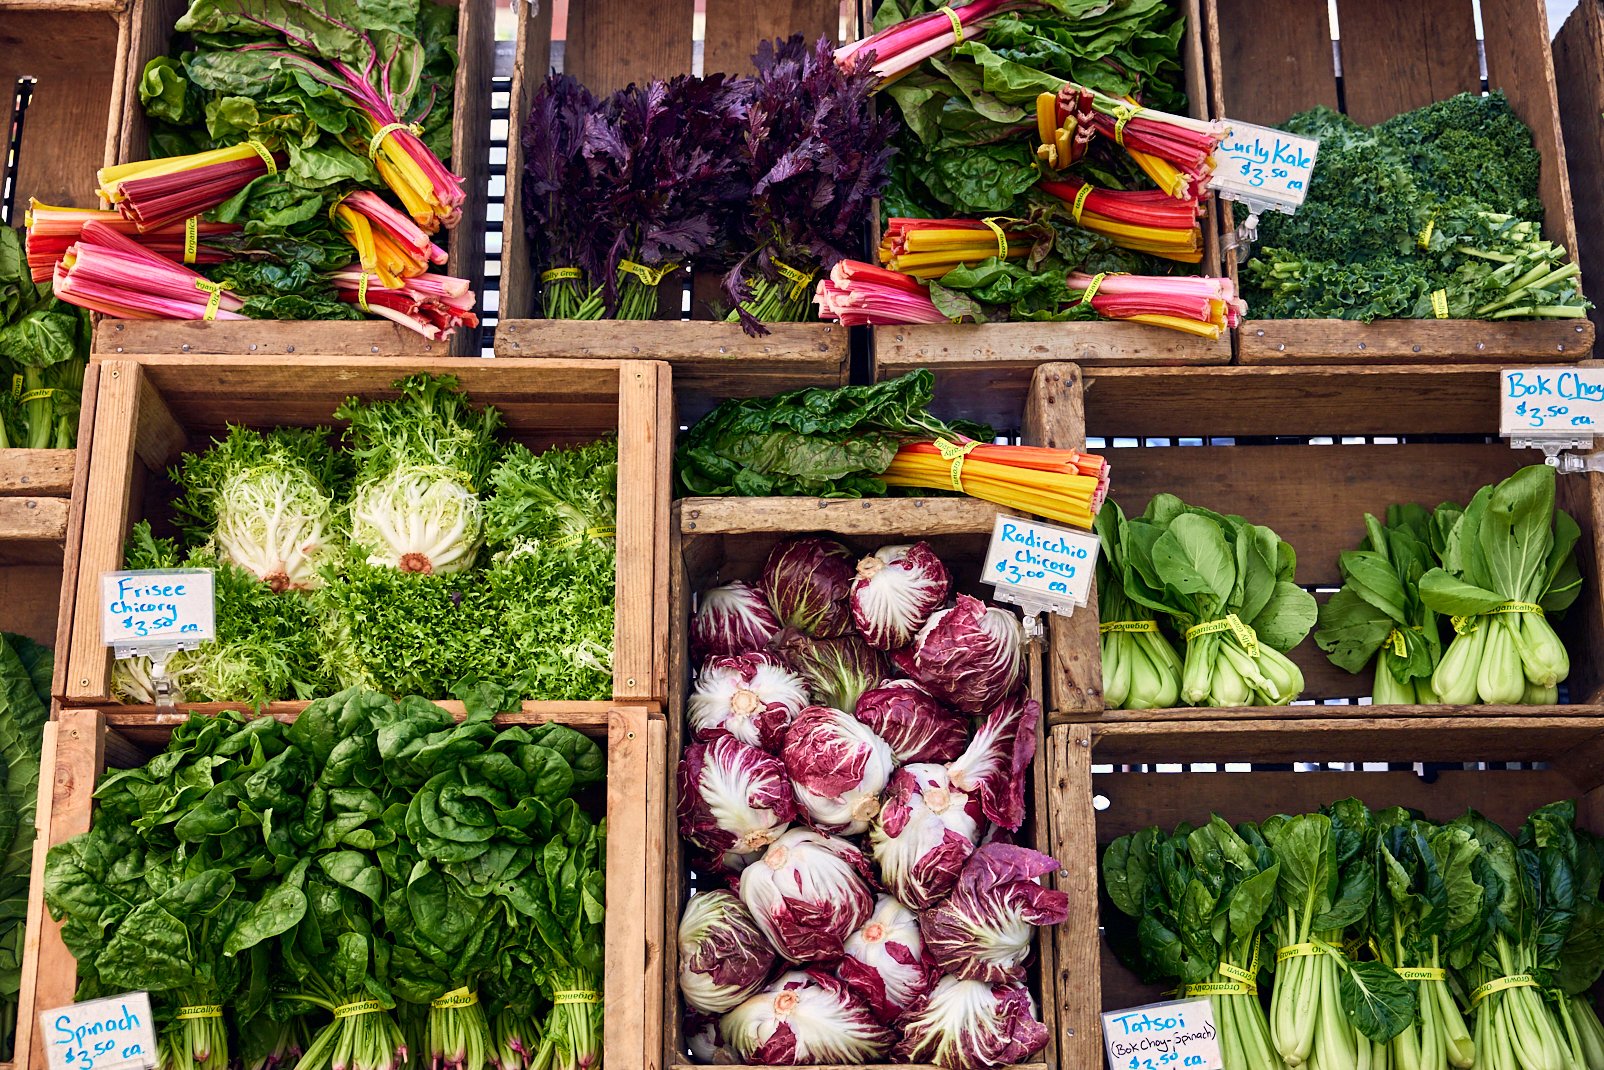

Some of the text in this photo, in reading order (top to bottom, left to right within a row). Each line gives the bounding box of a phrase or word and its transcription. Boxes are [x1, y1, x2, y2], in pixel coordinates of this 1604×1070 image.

[1220, 131, 1311, 168] Curly Kale
[1240, 162, 1288, 187] $3.50
[1076, 187, 1089, 209] Grown
[999, 233, 1008, 258] Grown
[1507, 372, 1604, 402] Bok Choy
[1515, 401, 1569, 427] $3.50
[953, 461, 961, 486] Grown
[1001, 523, 1088, 559] Radicchio
[1015, 549, 1076, 579] Chicory
[117, 577, 186, 600] Frisee
[996, 559, 1073, 595] $3.00 ea.
[1487, 604, 1535, 612] rganically
[121, 615, 174, 637] $3.50
[1226, 966, 1253, 981] Grown
[557, 991, 594, 1000] Organica
[1193, 984, 1240, 993] Organically
[55, 1004, 142, 1049] Spinach
[1112, 1013, 1186, 1035] Tatsoi
[65, 1039, 116, 1070] $3.50
